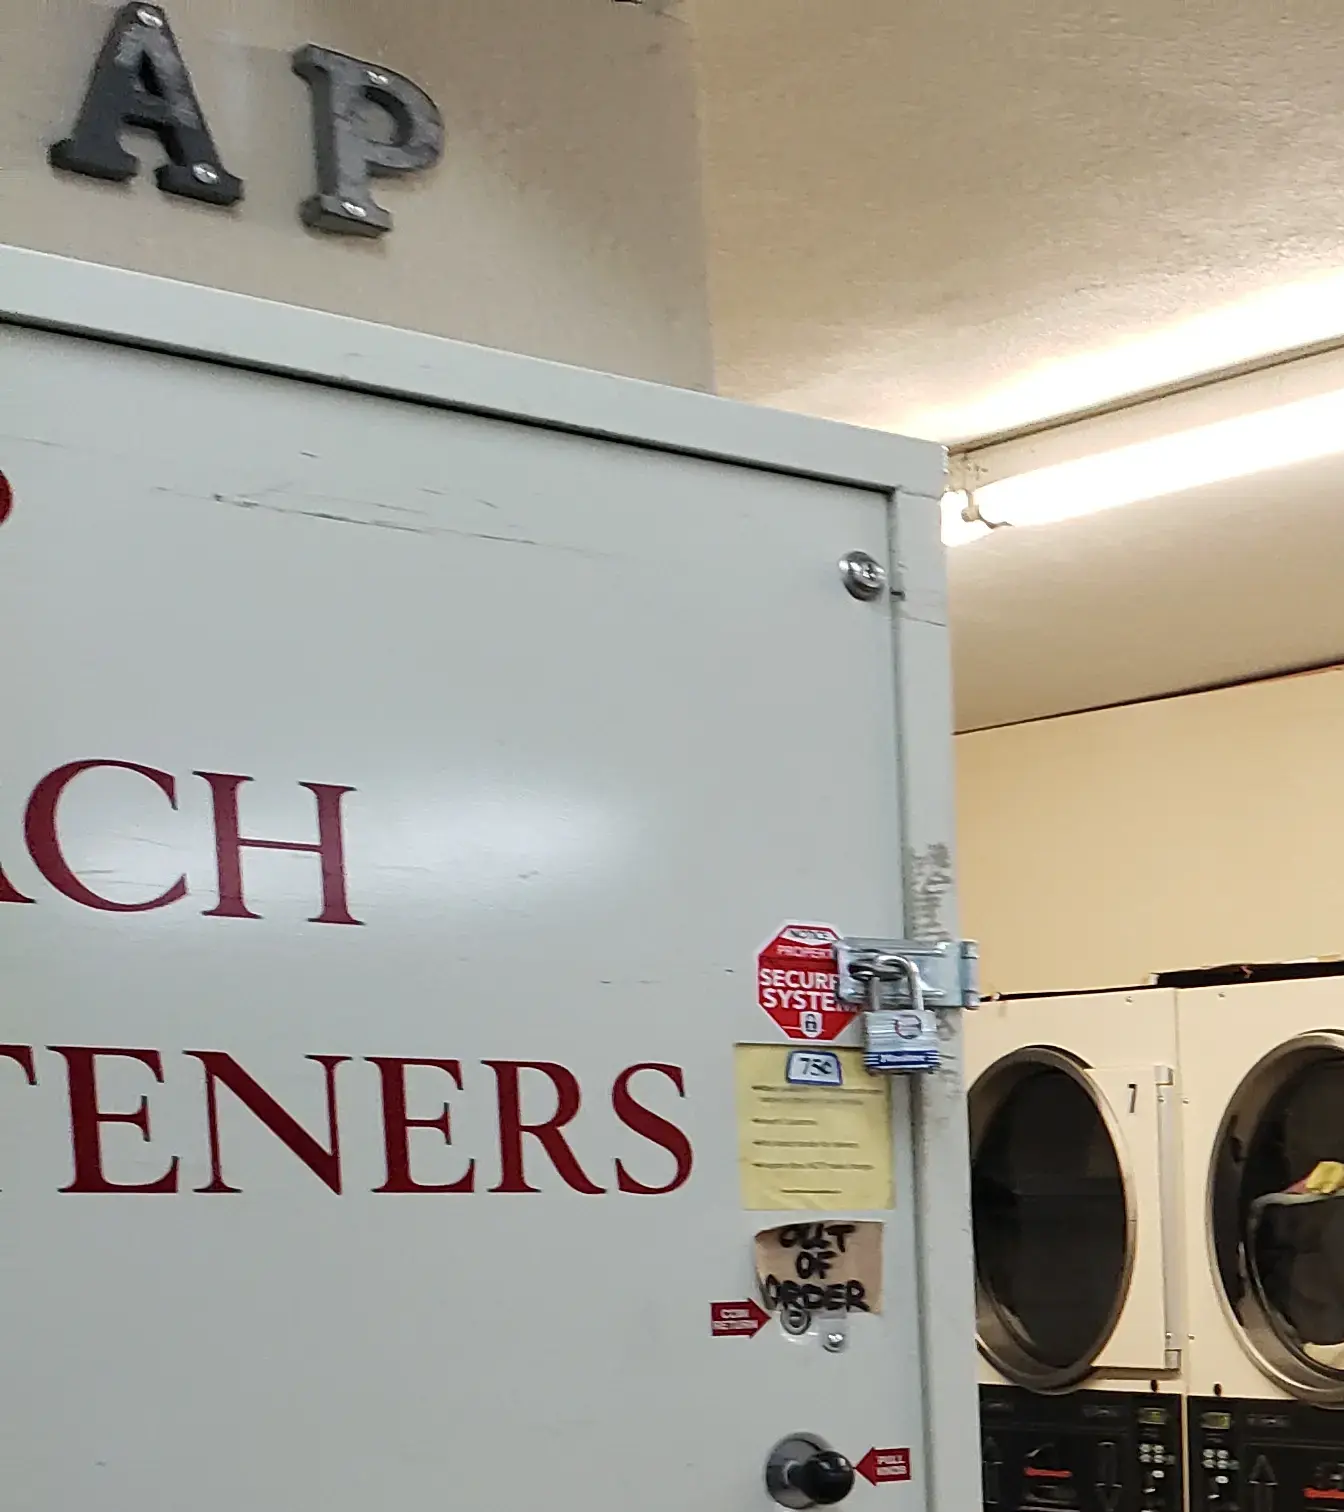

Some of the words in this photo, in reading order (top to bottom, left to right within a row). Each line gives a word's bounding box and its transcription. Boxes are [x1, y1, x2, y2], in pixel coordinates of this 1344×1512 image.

[0, 758, 365, 926] CH
[1127, 1083, 1138, 1114] 7
[779, 1223, 857, 1253] OUT
[795, 1250, 837, 1279] OF
[765, 1274, 870, 1313] ORDER
